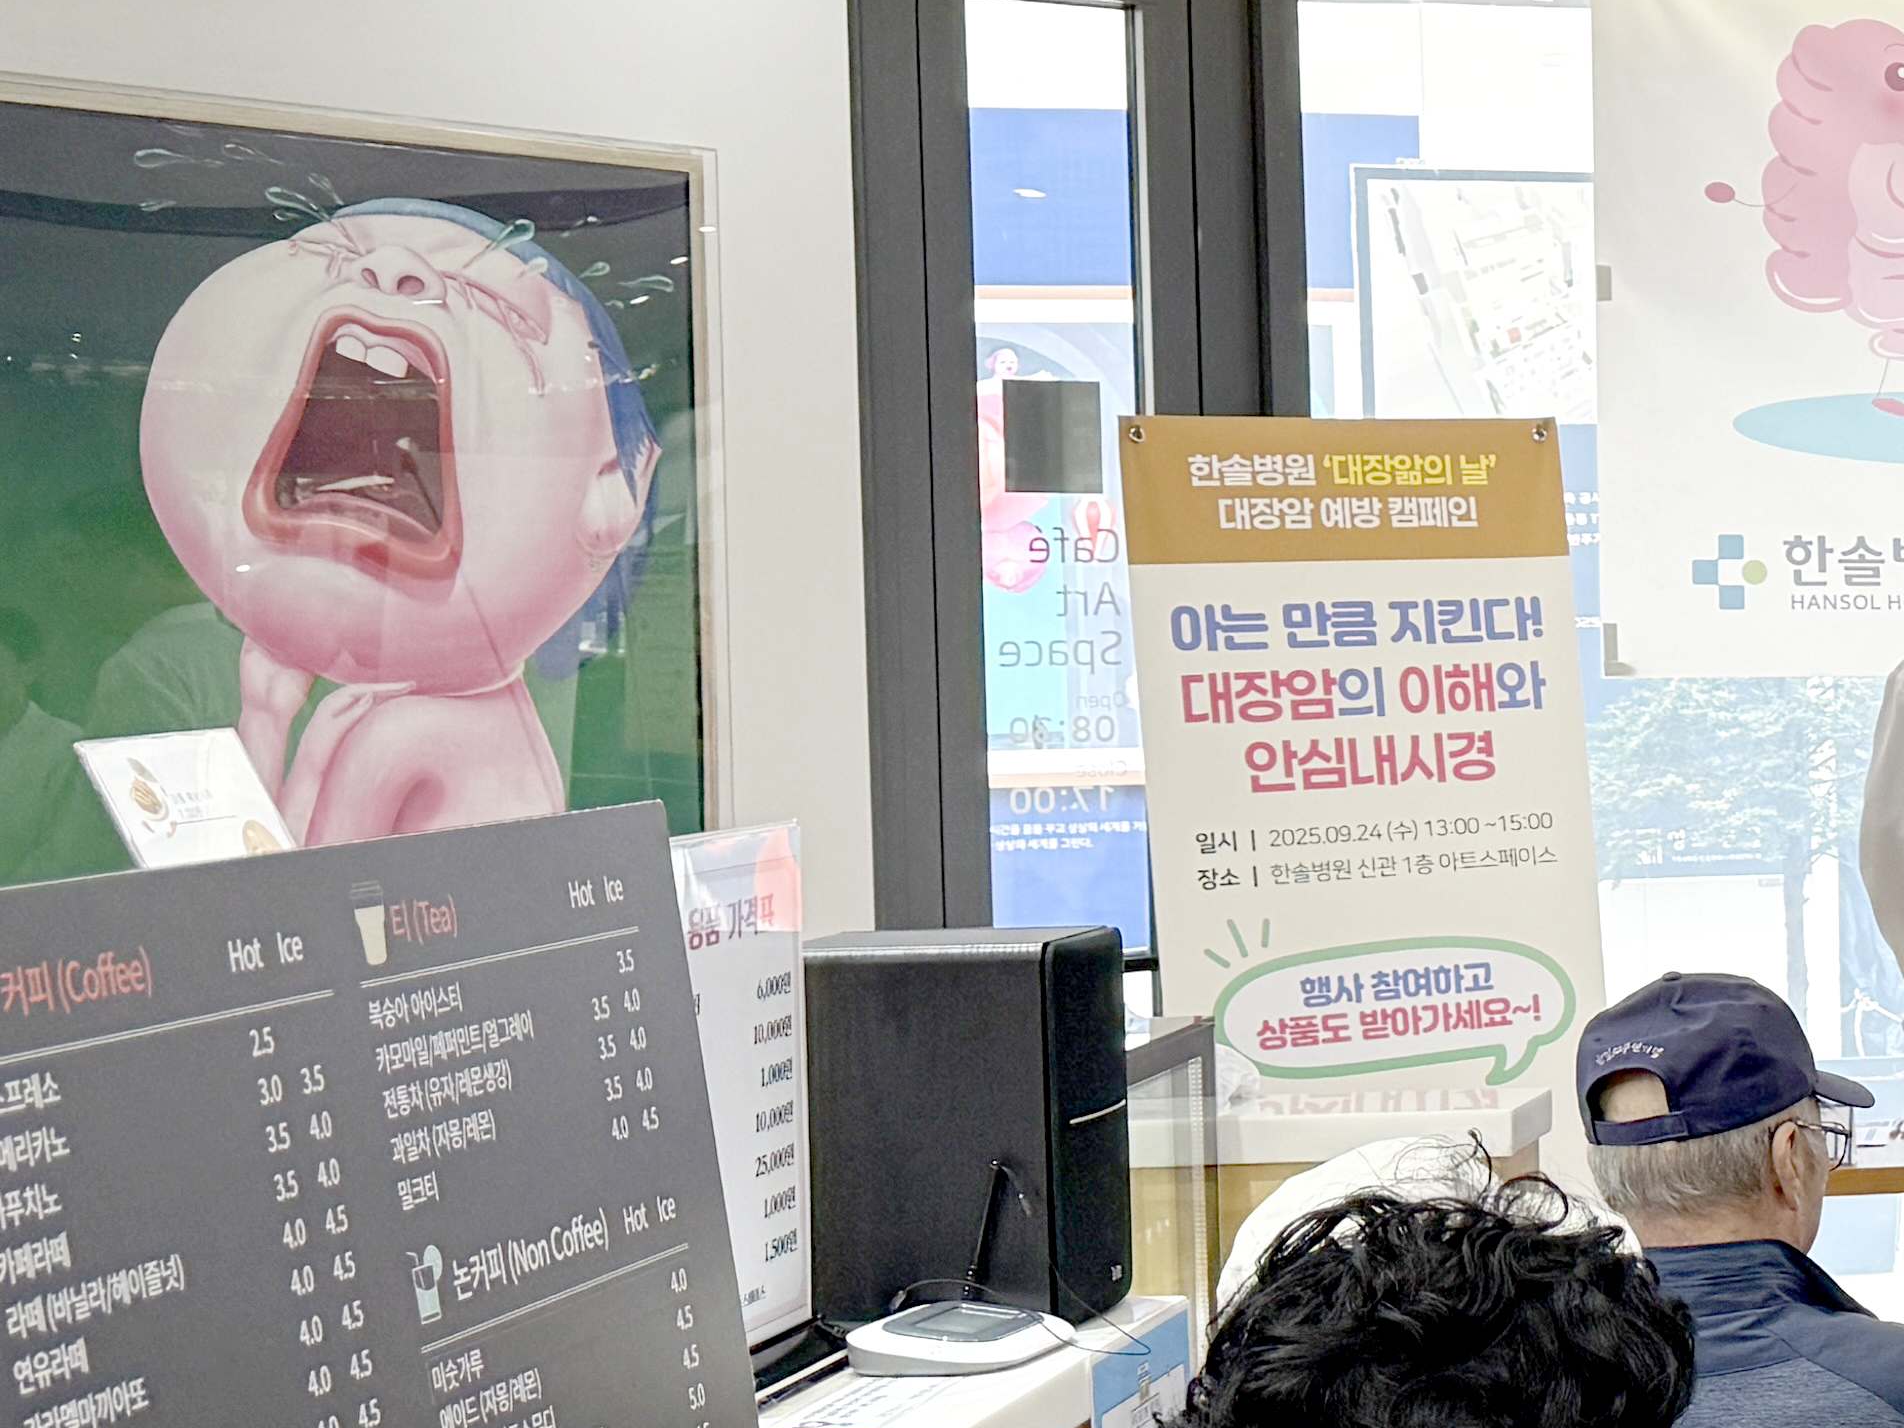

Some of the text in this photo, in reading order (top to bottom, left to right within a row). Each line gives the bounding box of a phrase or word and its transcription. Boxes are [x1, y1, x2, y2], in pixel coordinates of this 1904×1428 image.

[1188, 453, 1317, 487] 한솔병원
[1218, 495, 1479, 531] 대장암 예방 캠페인
[1170, 595, 1543, 652] 아는 만큼 지킨다!
[1790, 593, 1882, 611] HANSOL
[1180, 660, 1547, 725] 대장암의 이해와
[1244, 730, 1498, 794] 안심내시경
[1195, 811, 1554, 856] 일시 2025.09.24 (수) 13:00 ~15:00
[1197, 845, 1559, 891] 장소 한솔병원 신관 1층 아트스페이스
[389, 875, 625, 946] 티 (Tea) Hot Ice
[726, 892, 776, 942] 가격표
[1, 931, 304, 1016] 커피 (Coffee) Hot Ice
[1299, 961, 1495, 1009] 행사 참여하고
[368, 981, 464, 1030] 복숭아 아이스티
[1256, 993, 1542, 1052] 상품도 받아가세요~!
[752, 1013, 794, 1047] 10,000원
[759, 1056, 794, 1089] 1,000원
[381, 1079, 424, 1120] 전통차
[753, 1099, 795, 1134] 10,000원
[389, 1108, 497, 1165] 과일차 (자몽/레몬)
[753, 1140, 796, 1179] 25,000원
[273, 1169, 299, 1202] 3.5
[317, 1157, 341, 1188] 4.0
[396, 1170, 440, 1212] 밀크티
[5, 1294, 48, 1339] 라떼
[282, 1218, 307, 1250] 4.0
[325, 1204, 349, 1235] 4.5
[451, 1194, 677, 1302] 논커피 (Non Coffee) Hot Ice
[12, 1251, 357, 1395] 연유라떼 4.0 4.5
[299, 1315, 324, 1347] 4.0
[341, 1300, 365, 1330] 4.5
[308, 1365, 332, 1397] 4.0
[349, 1348, 373, 1380] 4.5
[430, 1348, 485, 1395] 미숫가루
[358, 1398, 382, 1428] 4.5
[479, 1368, 544, 1424] (자몽/레몬)
